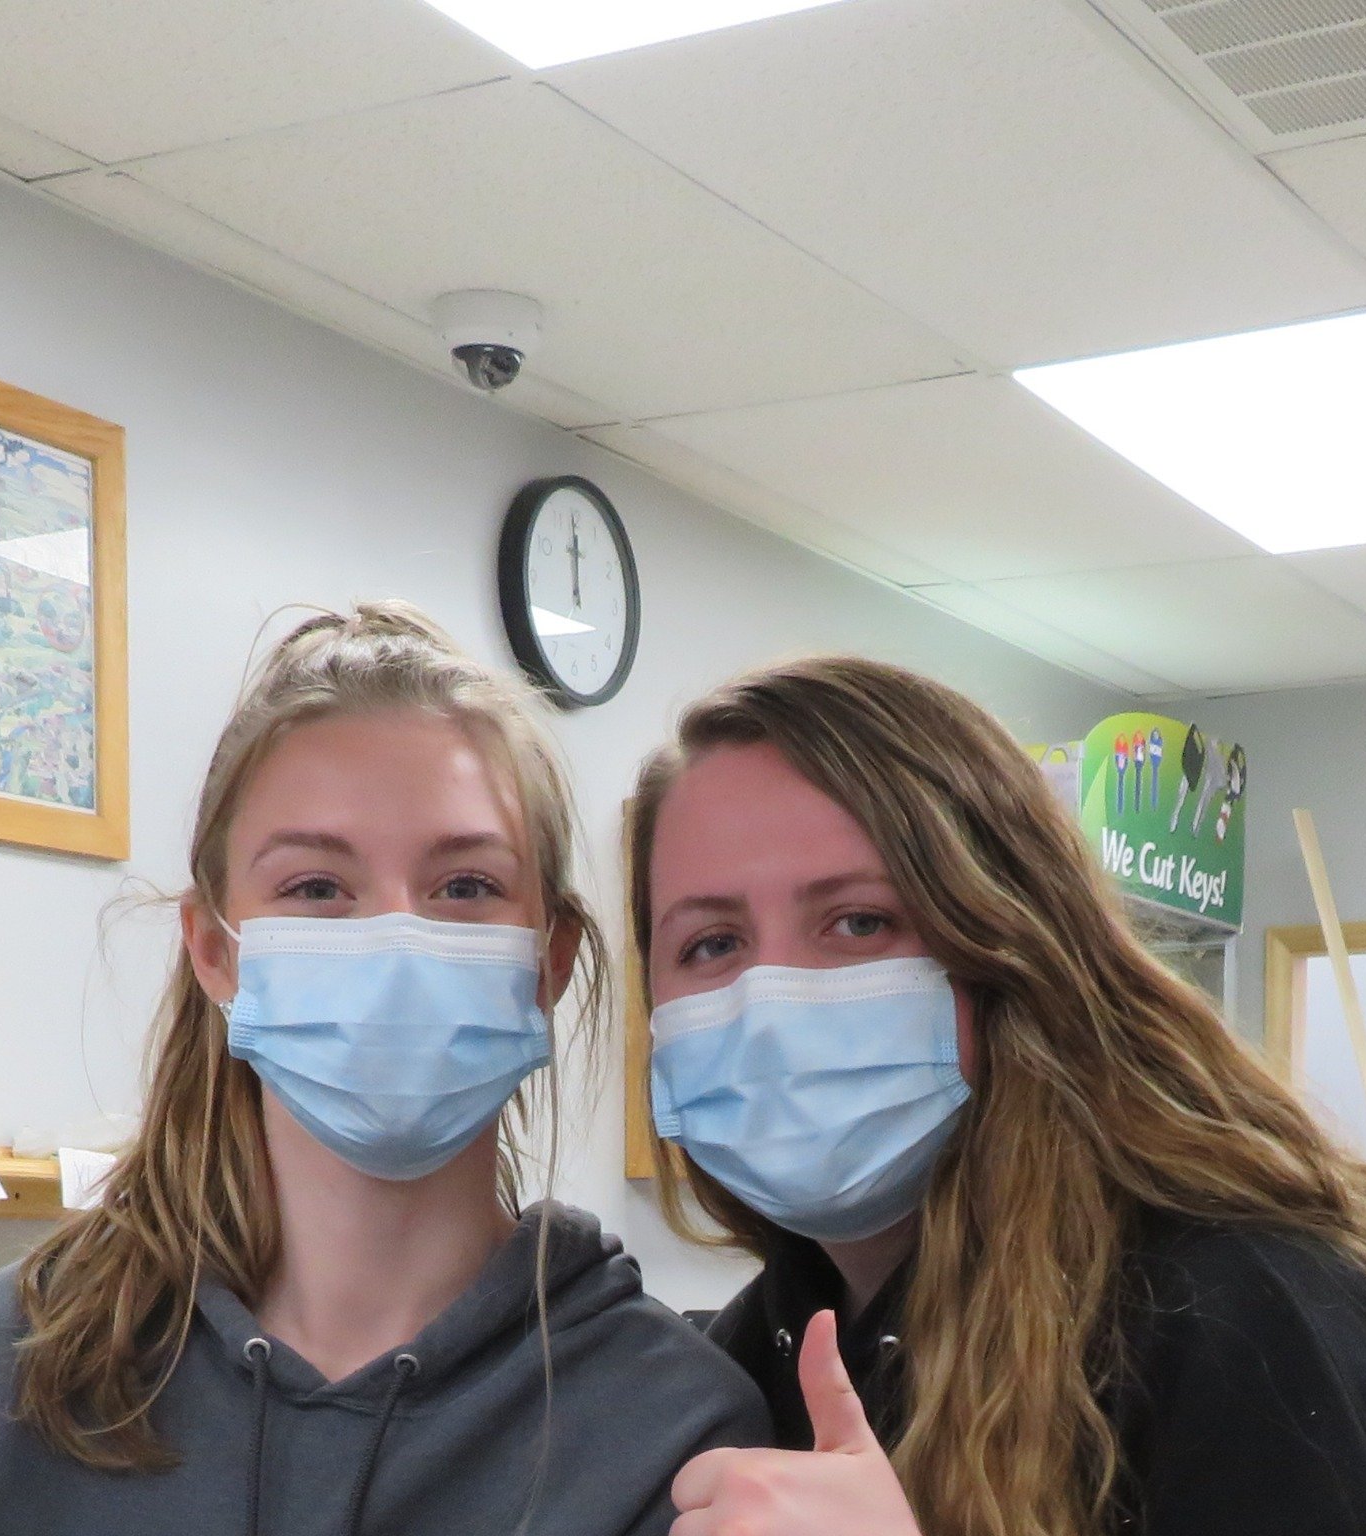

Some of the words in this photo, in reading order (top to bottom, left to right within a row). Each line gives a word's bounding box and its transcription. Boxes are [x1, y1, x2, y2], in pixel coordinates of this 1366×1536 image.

[1102, 826, 1135, 877] We
[1139, 842, 1176, 891] Cut
[1179, 855, 1227, 914] Keys!
